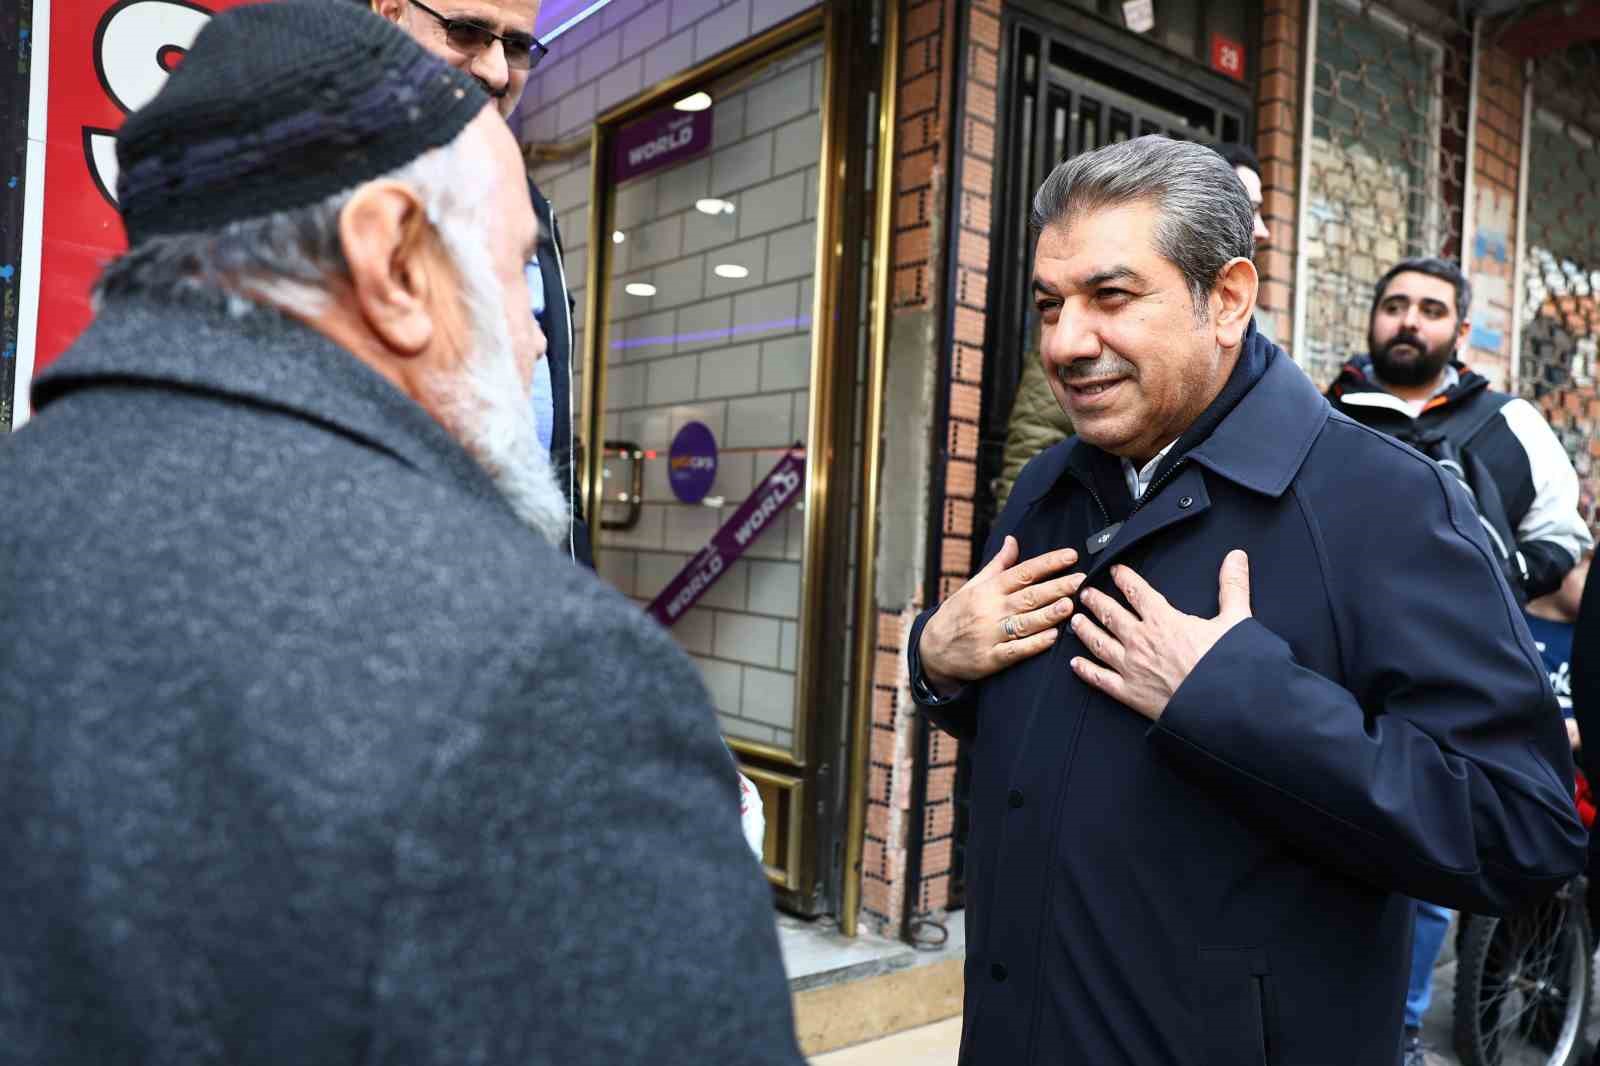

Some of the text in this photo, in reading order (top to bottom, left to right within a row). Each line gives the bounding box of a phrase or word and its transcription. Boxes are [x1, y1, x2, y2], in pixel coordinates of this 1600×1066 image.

[628, 126, 694, 165] WORLD
[735, 470, 800, 545] WORLD
[665, 555, 723, 617] WORLD
